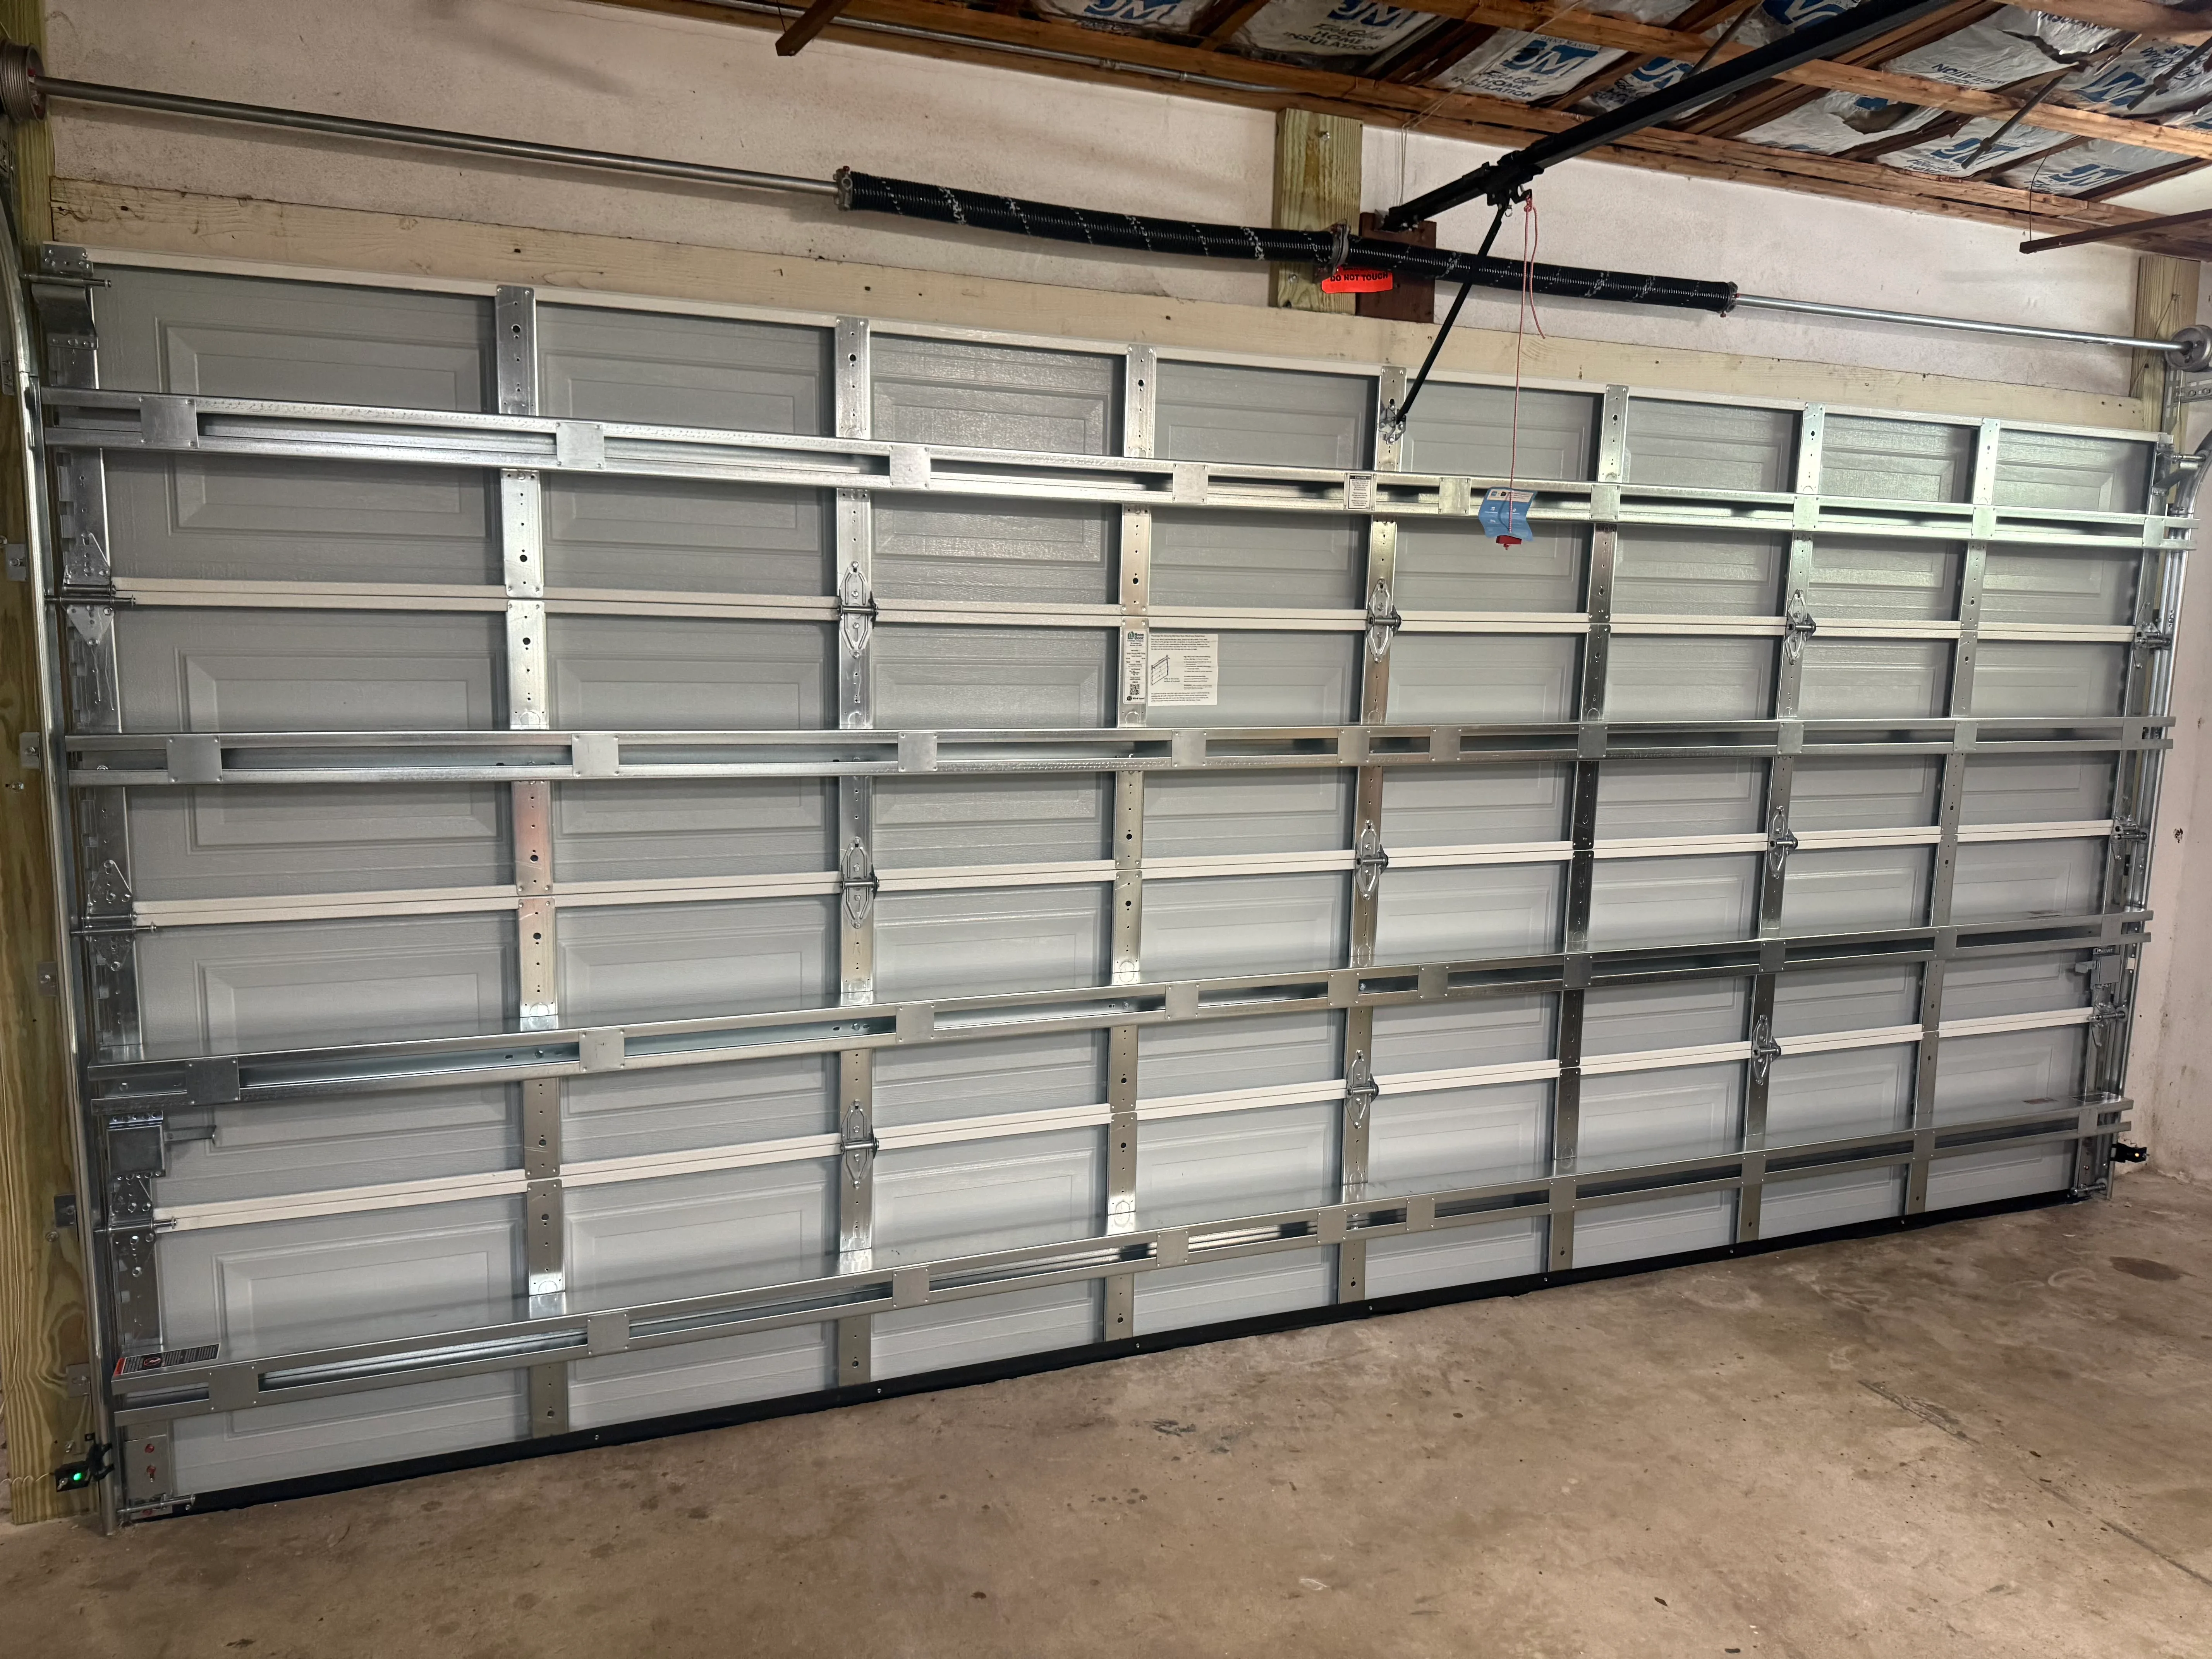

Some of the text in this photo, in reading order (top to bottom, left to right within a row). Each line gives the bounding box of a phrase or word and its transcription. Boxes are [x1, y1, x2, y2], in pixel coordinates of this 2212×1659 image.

[1283, 31, 1380, 51] INSULATION
[1315, 31, 1365, 45] HOME
[1500, 39, 1599, 76] JM
[1451, 76, 1537, 97] INSULATION
[1481, 78, 1525, 91] HOME
[1360, 272, 1388, 281] TOUCH
